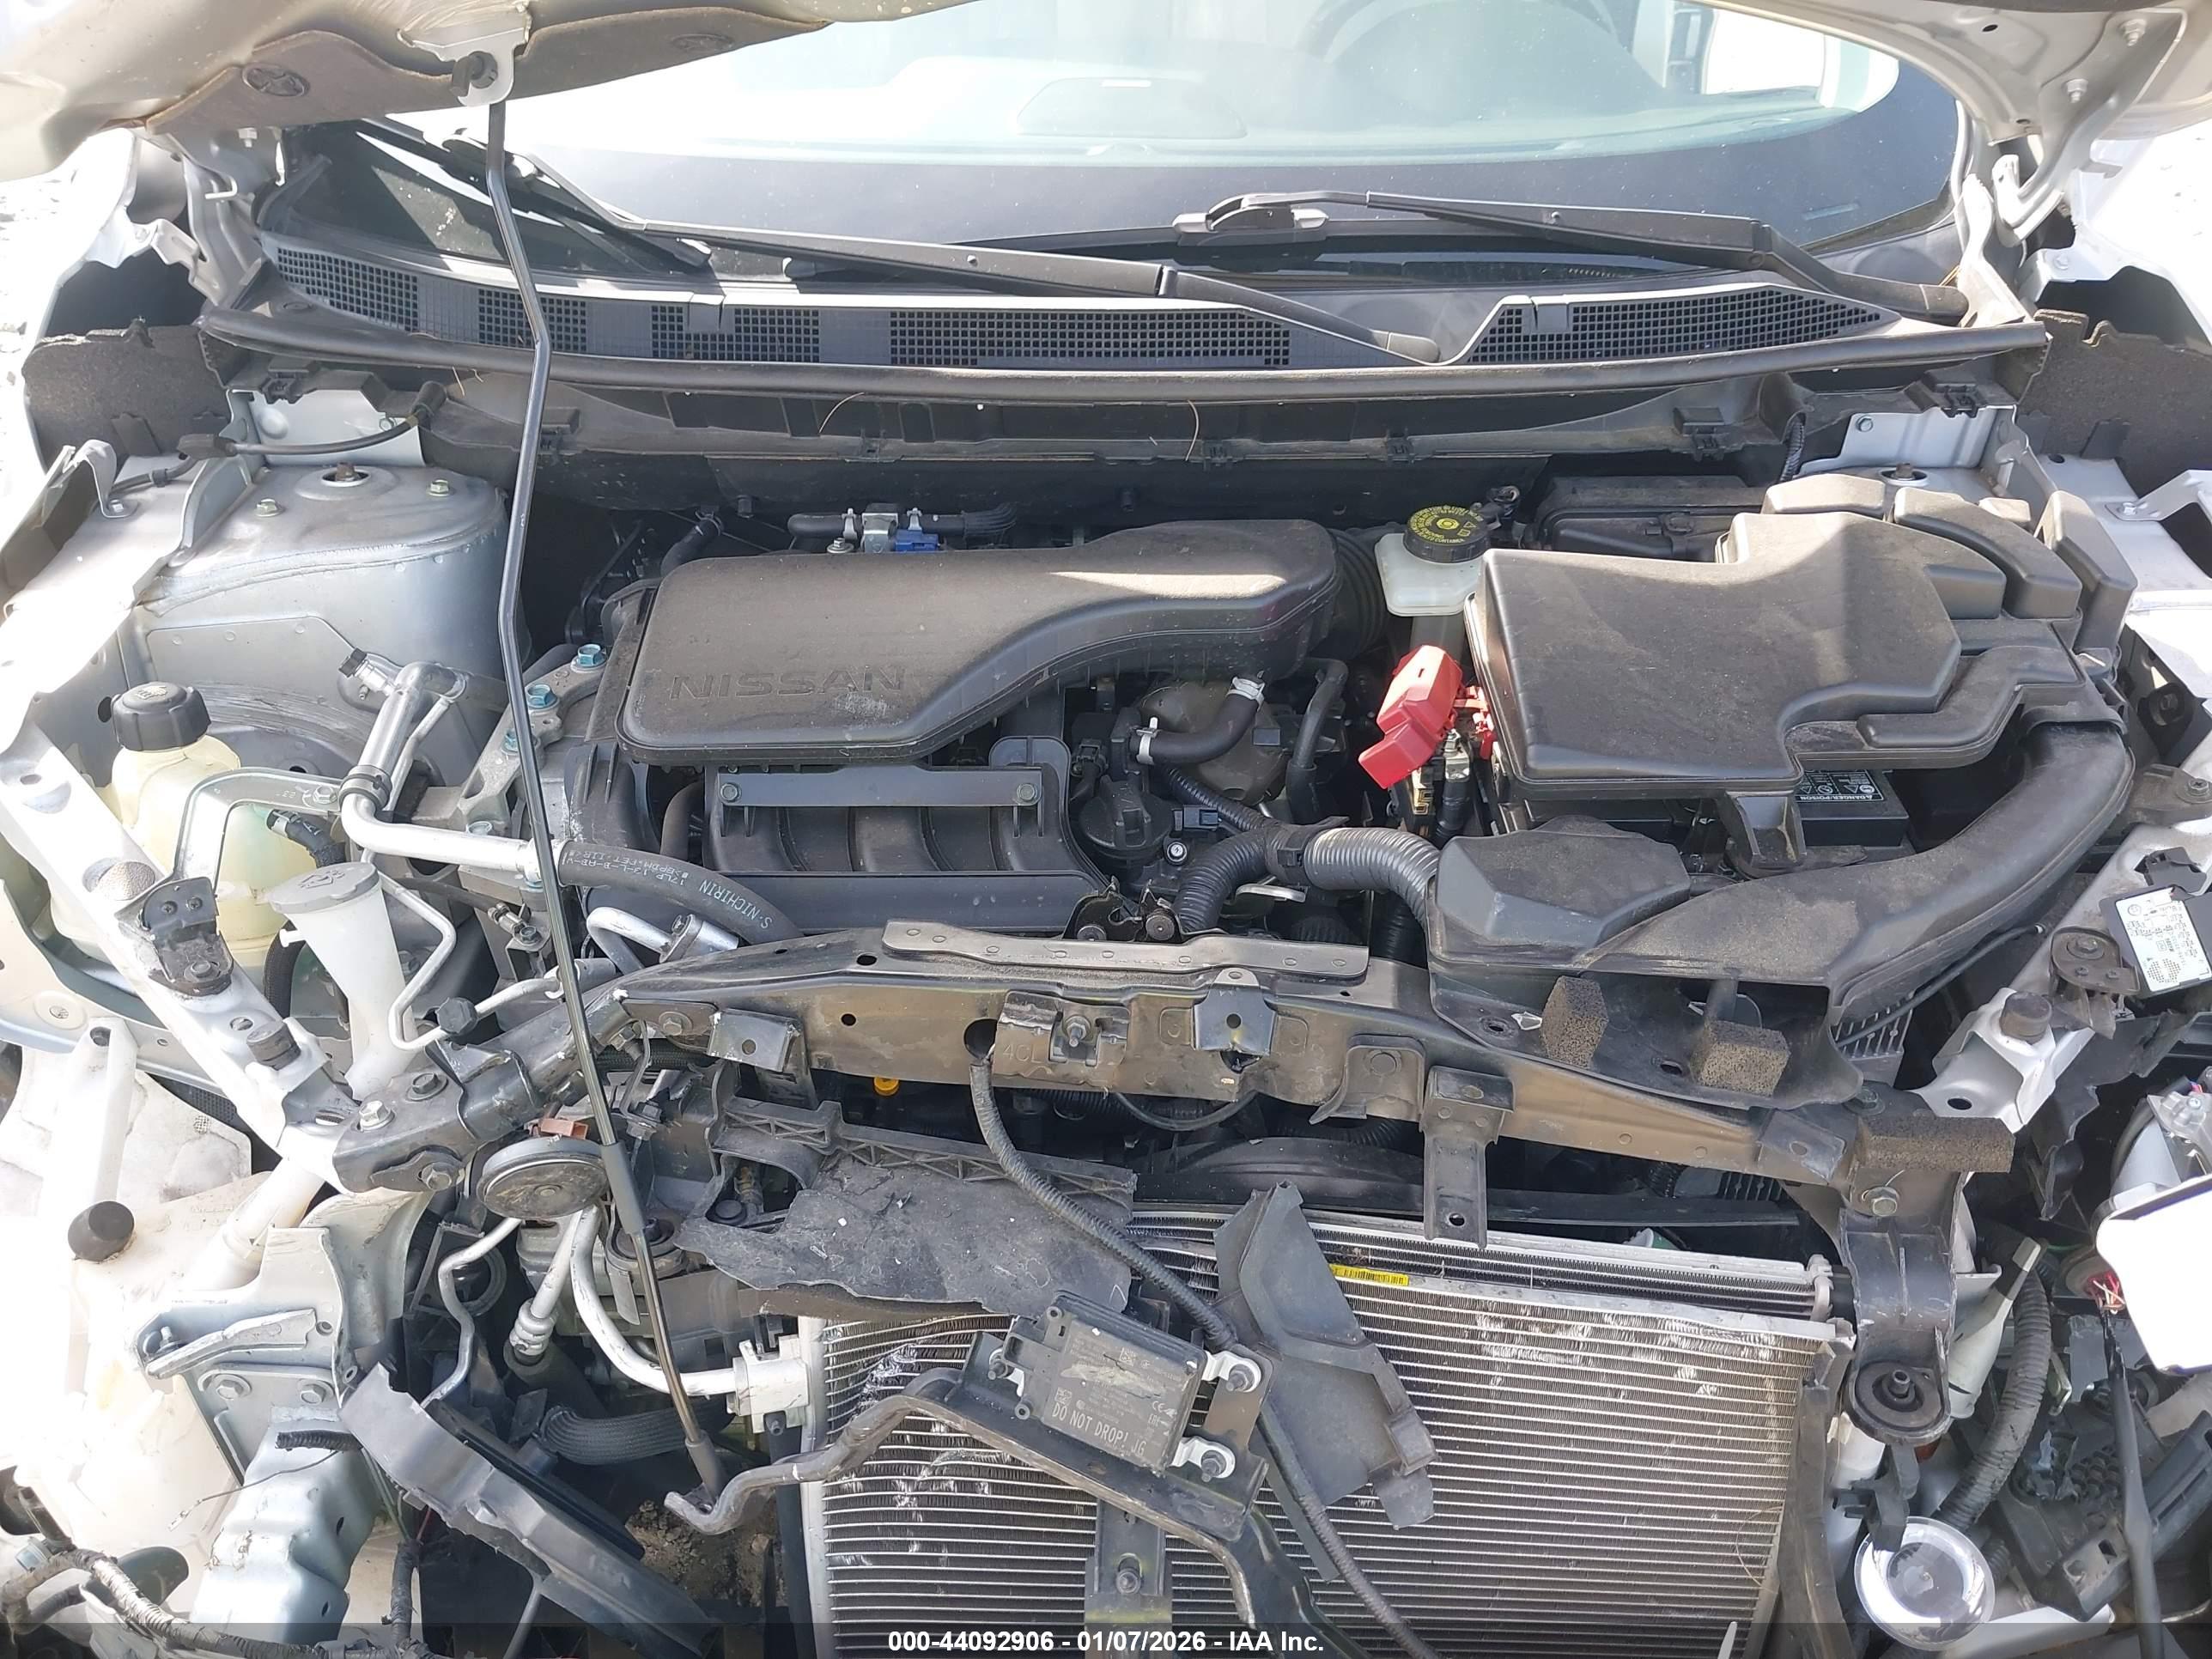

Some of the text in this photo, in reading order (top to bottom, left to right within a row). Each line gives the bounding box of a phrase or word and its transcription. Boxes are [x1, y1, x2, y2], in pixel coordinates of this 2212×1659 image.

[669, 665, 904, 700] NISSAN
[1052, 1403, 1066, 1421] DO
[1069, 1413, 1093, 1432] NOT
[1094, 1423, 1129, 1449] DROP!
